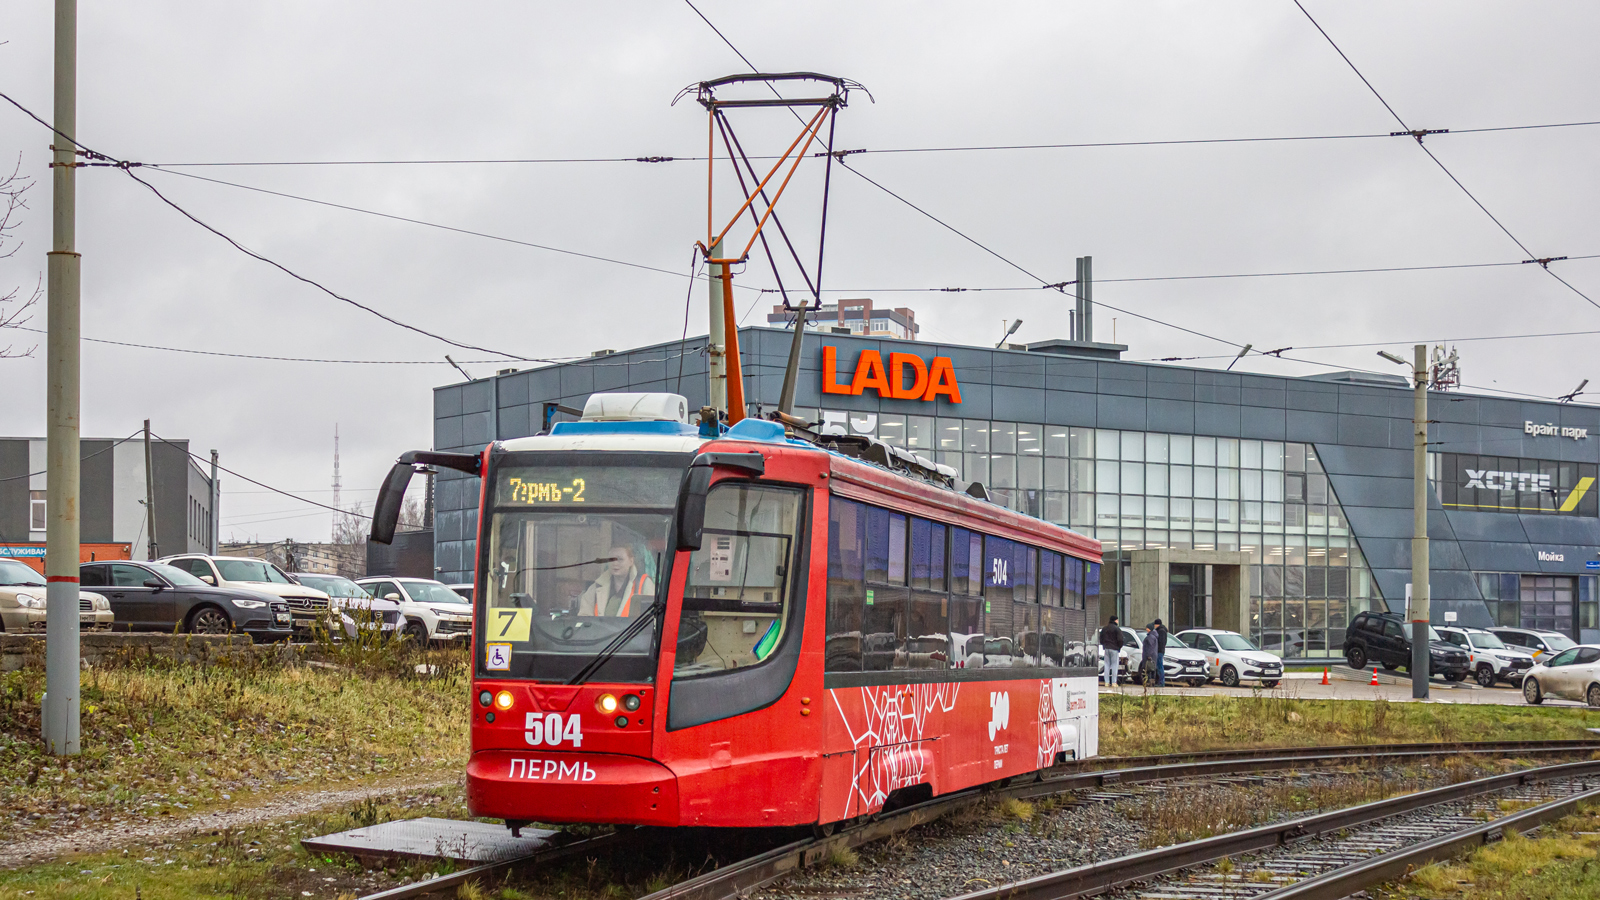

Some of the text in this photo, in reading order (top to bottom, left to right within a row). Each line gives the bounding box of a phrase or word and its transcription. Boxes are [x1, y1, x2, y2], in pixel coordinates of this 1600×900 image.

[822, 346, 962, 404] LADA
[1524, 420, 1588, 440] Брайт парк
[1464, 469, 1550, 492] XCITE
[1538, 551, 1564, 562] Мойка
[992, 558, 1008, 586] 504
[498, 611, 518, 637] 7
[524, 712, 583, 747] 504
[508, 758, 597, 782] ПЕРМЬ
